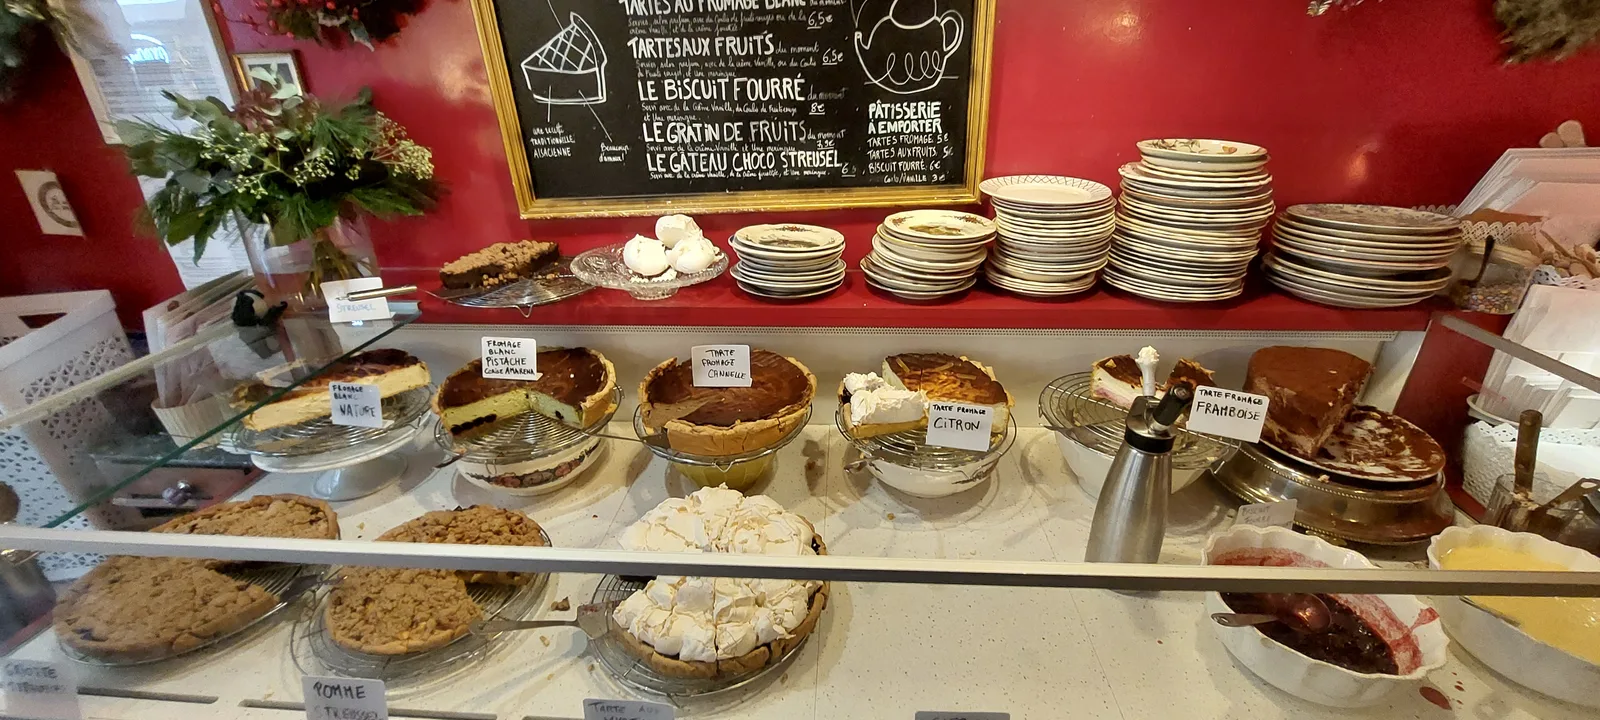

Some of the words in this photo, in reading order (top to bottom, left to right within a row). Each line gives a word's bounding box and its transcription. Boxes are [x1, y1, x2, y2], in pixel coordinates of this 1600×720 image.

[619, 0, 671, 15] TARTES
[674, 0, 693, 13] AU
[627, 36, 681, 59] TARTES
[682, 37, 710, 57] AUX
[776, 40, 787, 54] du
[790, 41, 820, 54] moment
[638, 79, 659, 101] LE
[733, 73, 805, 101] FOURRÉ
[807, 84, 818, 100] du
[810, 102, 825, 113] 8€
[643, 121, 664, 142] LE
[723, 121, 743, 142] DE
[807, 128, 816, 140] du
[878, 118, 942, 134] EMPORTER
[867, 135, 897, 147] TARTES
[867, 147, 895, 160] TARTES
[897, 147, 911, 158] AUX
[646, 153, 666, 172] LE
[669, 151, 727, 173] GÂTEAU
[732, 152, 775, 172] CHOCO
[780, 150, 842, 168] STREUSEL
[486, 340, 521, 348] FROMAGE
[705, 349, 735, 357] TARTE
[701, 358, 735, 367] FROMAGE
[708, 369, 746, 379] CANNELLE
[332, 384, 363, 393] FROMAGE
[333, 392, 359, 400] BLANC
[1199, 389, 1222, 397] TARTE
[1225, 392, 1263, 405] FROMAGE
[339, 404, 376, 417] NATURE
[957, 406, 986, 415] FROMAGE
[313, 681, 366, 700] POMME
[587, 702, 626, 713] TARTE
